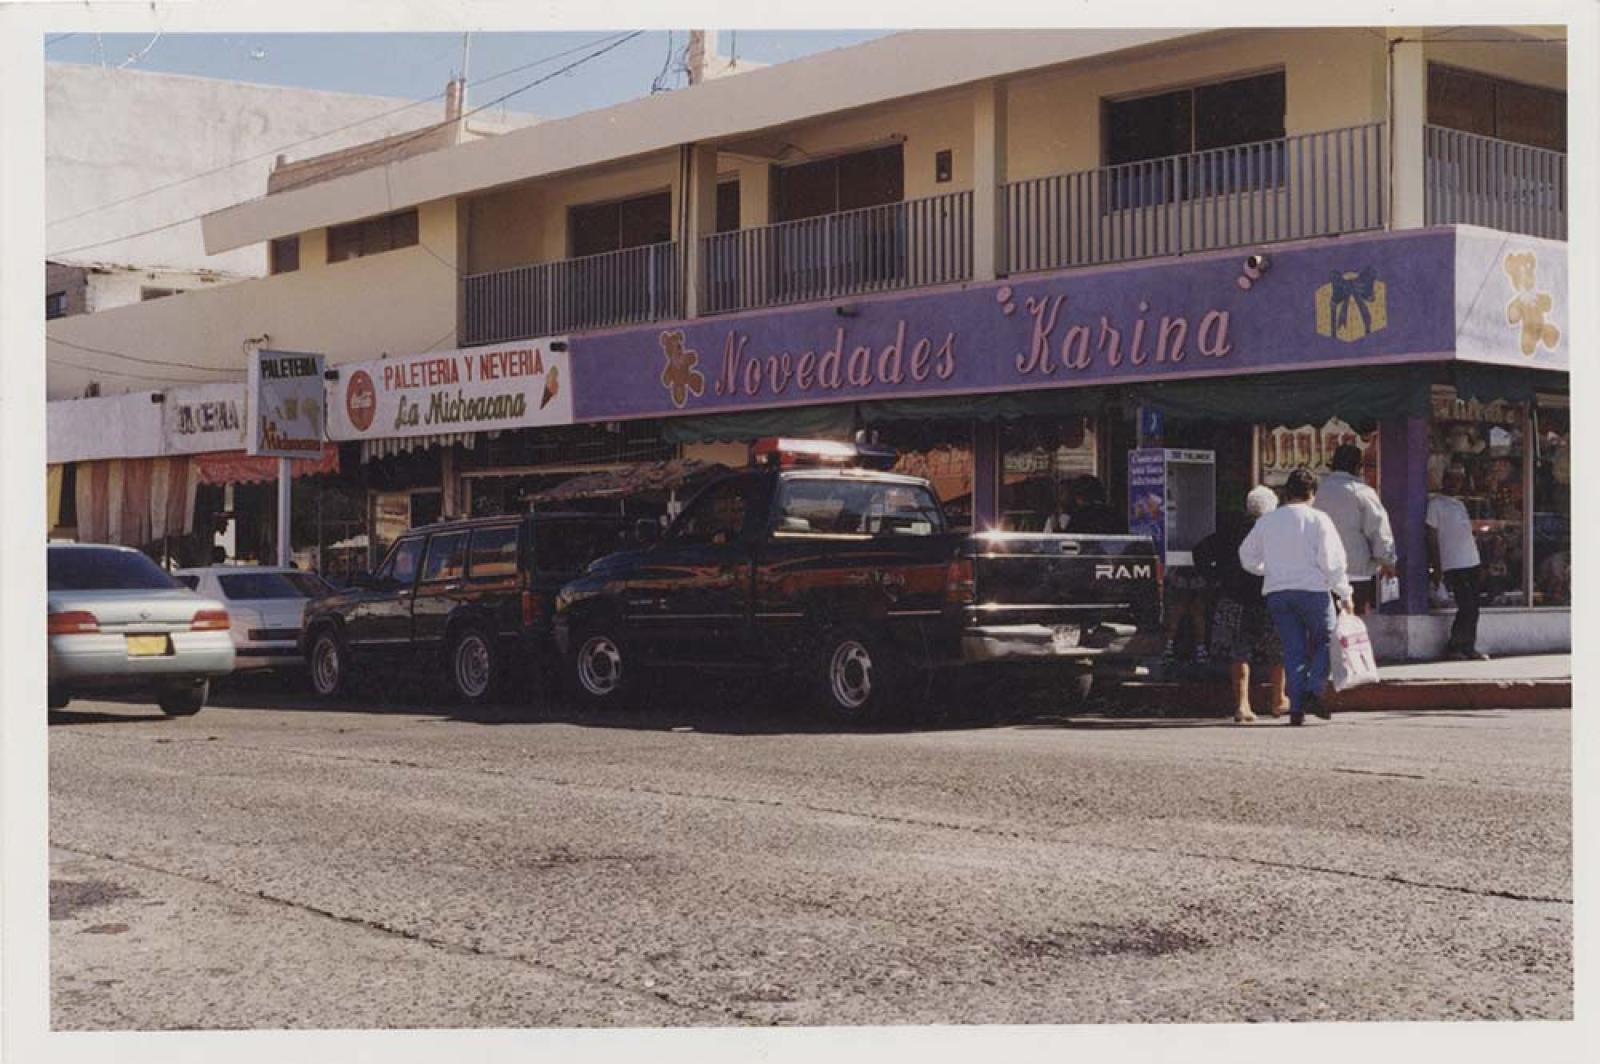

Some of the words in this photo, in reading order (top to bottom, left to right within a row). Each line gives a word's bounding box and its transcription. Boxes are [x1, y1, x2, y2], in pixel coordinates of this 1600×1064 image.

[715, 320, 957, 396] Novedades
[1015, 294, 1231, 375] Karina
[260, 357, 318, 379] PALETERIA
[383, 357, 460, 391] PALETERIA
[464, 354, 474, 383] Y
[479, 348, 545, 381] NEVERIA
[394, 395, 420, 429] La
[424, 389, 526, 424] Michoacana
[1095, 564, 1151, 580] RAM
